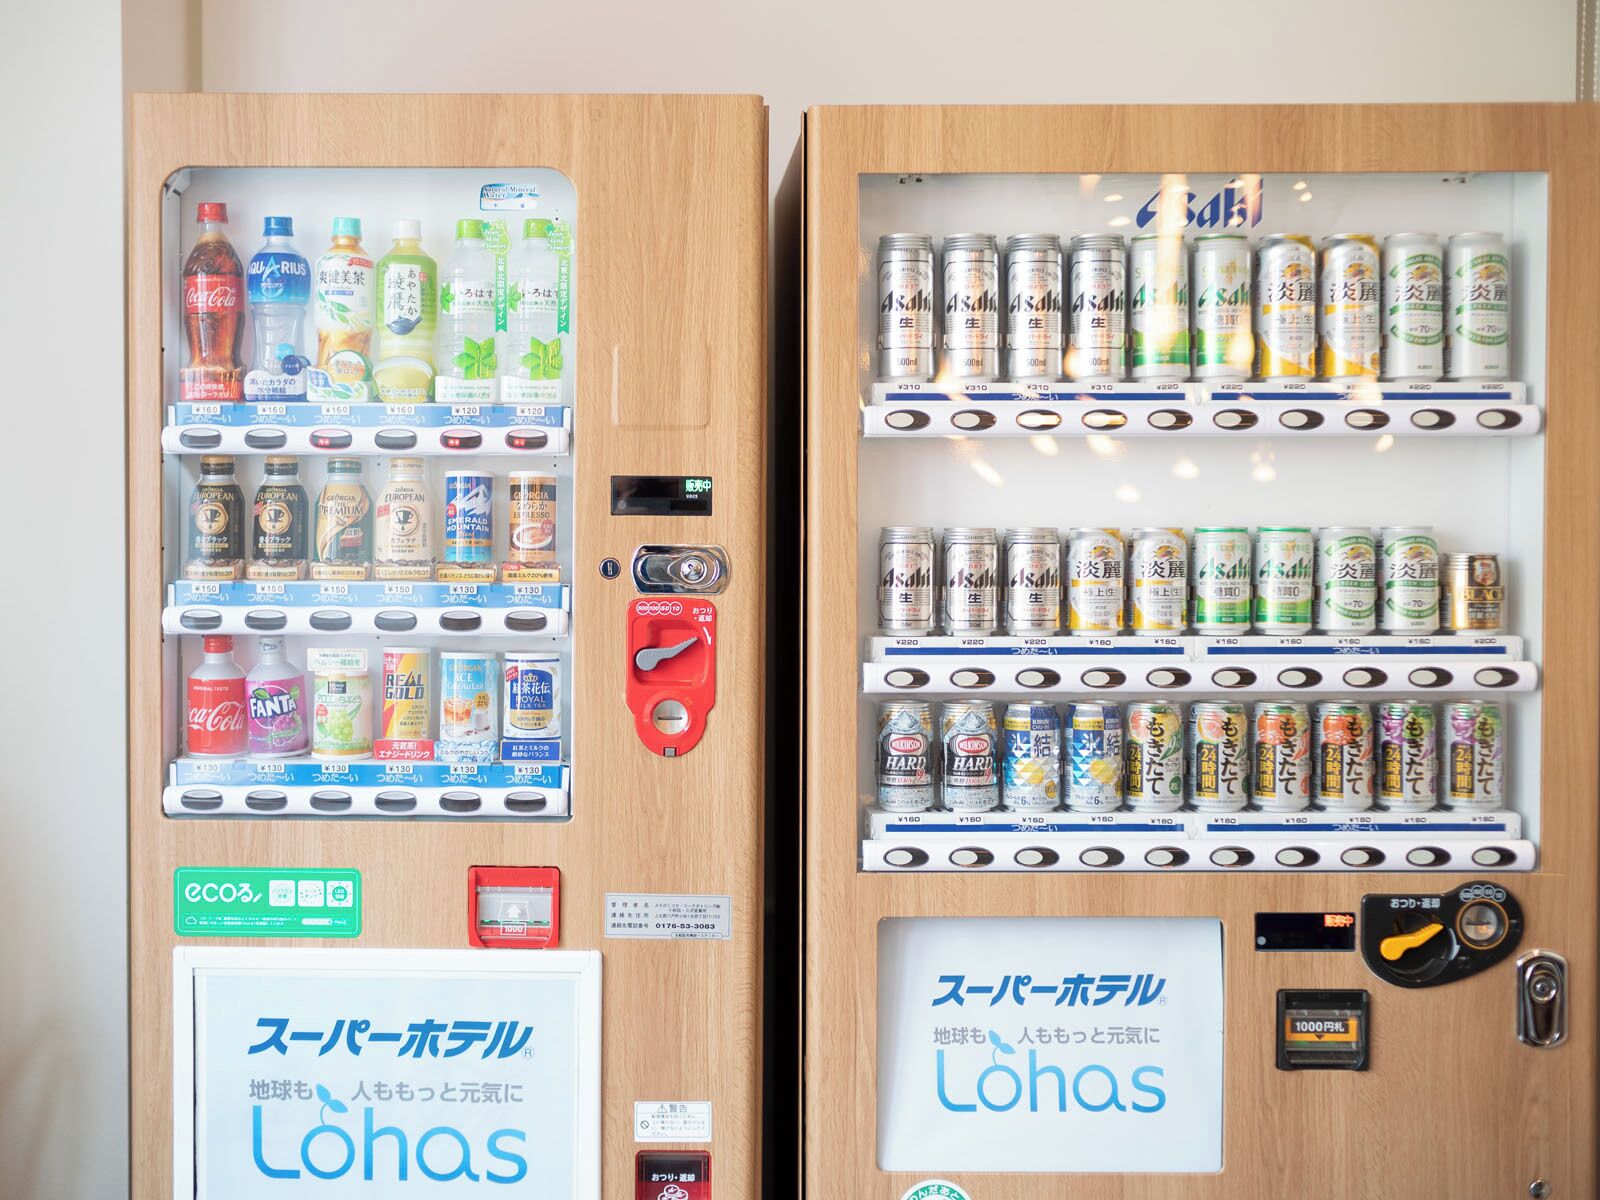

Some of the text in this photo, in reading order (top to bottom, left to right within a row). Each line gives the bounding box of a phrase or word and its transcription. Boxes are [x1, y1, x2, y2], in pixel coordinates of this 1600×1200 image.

[881, 288, 931, 313] Asahi
[946, 288, 998, 313] Asahi
[1009, 288, 1061, 313] Asahi
[1072, 288, 1123, 313] Asahi
[1268, 281, 1316, 302] 淡麗
[1330, 281, 1378, 302] 淡麗
[1396, 283, 1443, 302] 淡麗
[1461, 283, 1507, 302] 淡麗
[899, 317, 914, 328] 生
[965, 317, 980, 329] 生
[1028, 317, 1044, 329] 生
[1091, 317, 1107, 329] 生
[385, 493, 425, 502] EUROPEAN
[447, 517, 488, 525] EMERALD
[883, 566, 932, 588] Asahi
[949, 566, 998, 589] Asahi
[1076, 560, 1122, 579] 淡麗
[1141, 560, 1186, 579] 淡麗
[1199, 557, 1251, 580] Asahi
[1259, 556, 1312, 580] Asahi
[1331, 563, 1376, 579] 淡麗
[1389, 563, 1437, 579] 淡麗
[1010, 567, 1059, 589] Asahi
[899, 592, 913, 603] 生
[968, 592, 982, 604] 生
[1029, 592, 1043, 604] 生
[386, 671, 425, 686] REAL
[512, 682, 551, 694] 紅茶花伝
[385, 687, 425, 700] GOLD
[250, 694, 297, 719] FANTA
[379, 750, 430, 759] エナジードリンク
[886, 756, 927, 770] HARD
[953, 756, 993, 770] HARD
[1146, 716, 1165, 795] もぎたて
[1221, 716, 1239, 795] もぎたて
[1279, 716, 1298, 795] もぎたて
[1346, 716, 1364, 795] もぎたて
[1405, 716, 1424, 795] もぎたて
[1477, 716, 1495, 795] もぎたて
[324, 765, 347, 773] ¥130
[453, 766, 475, 774] ¥130
[932, 973, 1166, 1007] スーパーホテル
[933, 1026, 1161, 1045] 地球も 人ももっと元気に
[1295, 1021, 1345, 1032] 1000円札
[248, 1018, 534, 1059] スーパーホテル
[936, 1049, 1166, 1113] Lohas
[249, 1079, 523, 1104] 地球も 人ももっと元気に
[252, 1105, 528, 1184] Lohas
[651, 1173, 696, 1181] おつり・返却
